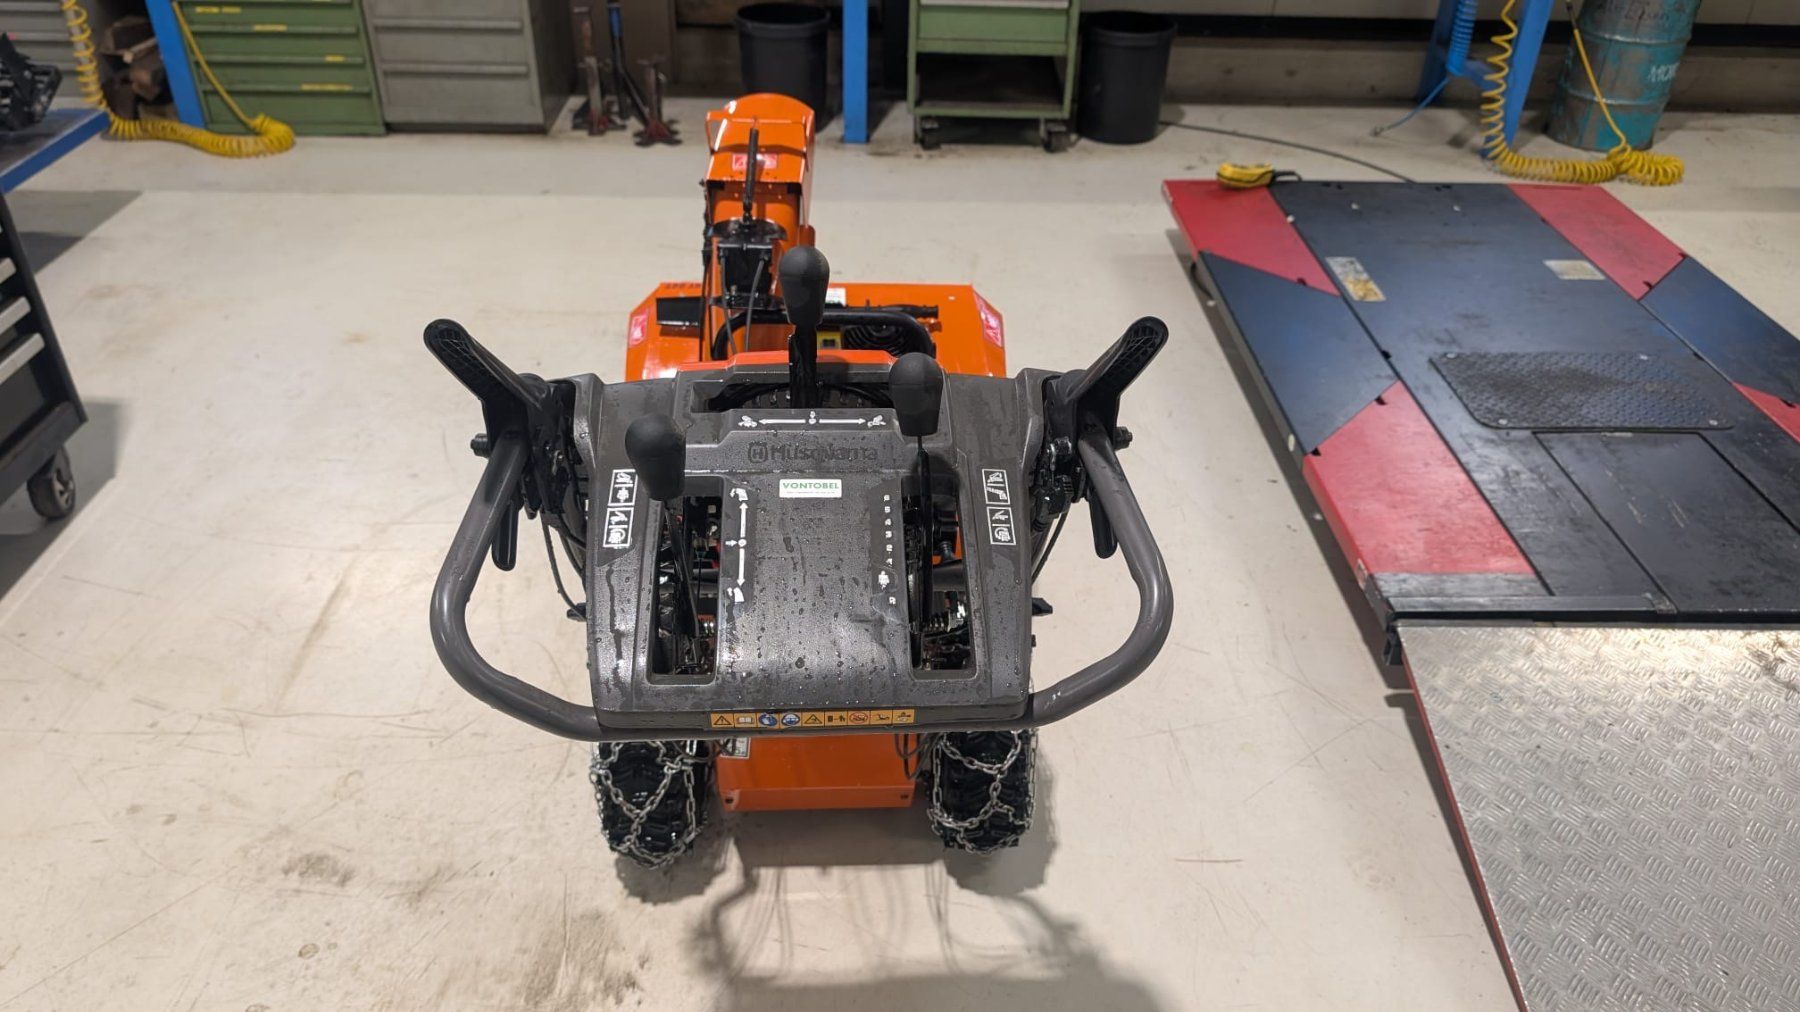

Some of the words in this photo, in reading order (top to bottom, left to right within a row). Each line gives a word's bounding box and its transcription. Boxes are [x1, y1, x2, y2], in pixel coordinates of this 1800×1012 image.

[884, 518, 892, 526] 4
[885, 530, 892, 538] 3
[889, 596, 896, 605] R
